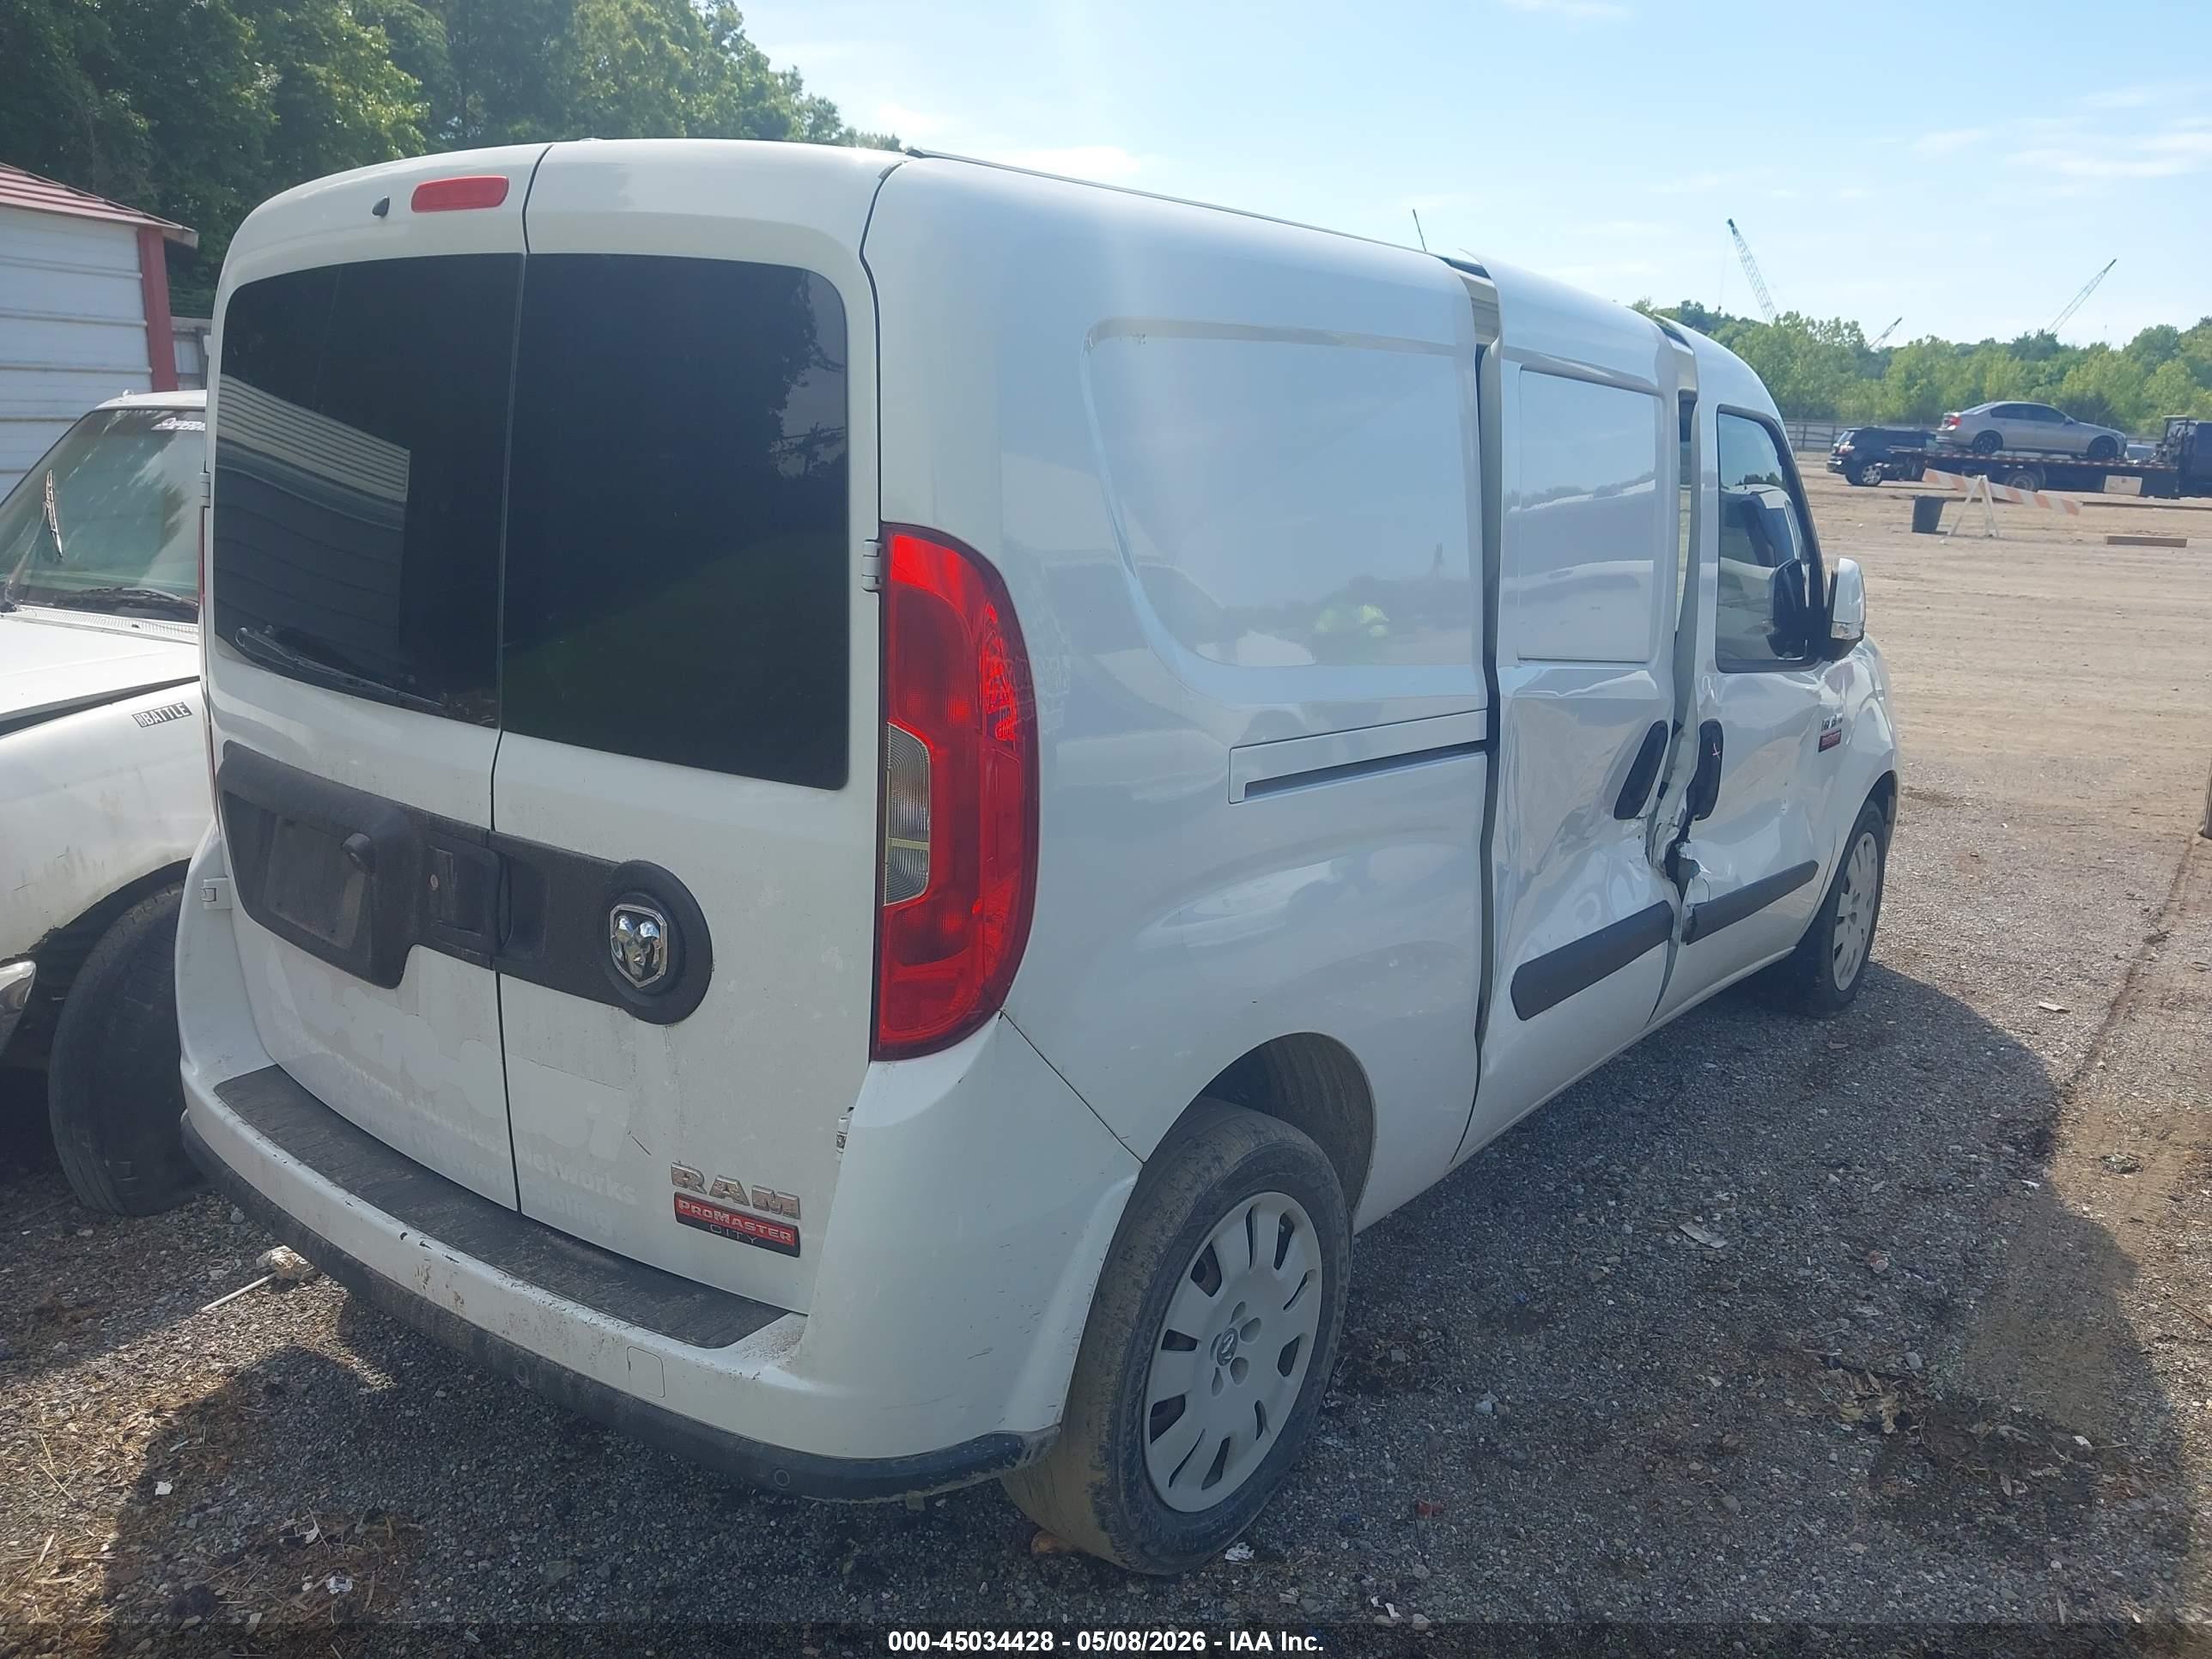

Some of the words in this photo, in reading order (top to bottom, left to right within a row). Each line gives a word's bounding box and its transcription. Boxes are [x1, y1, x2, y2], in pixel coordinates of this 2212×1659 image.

[141, 703, 190, 725] BATTLE
[670, 1162, 801, 1219] RAM
[678, 1200, 792, 1242] PROMASTER
[709, 1224, 758, 1244] CITY
